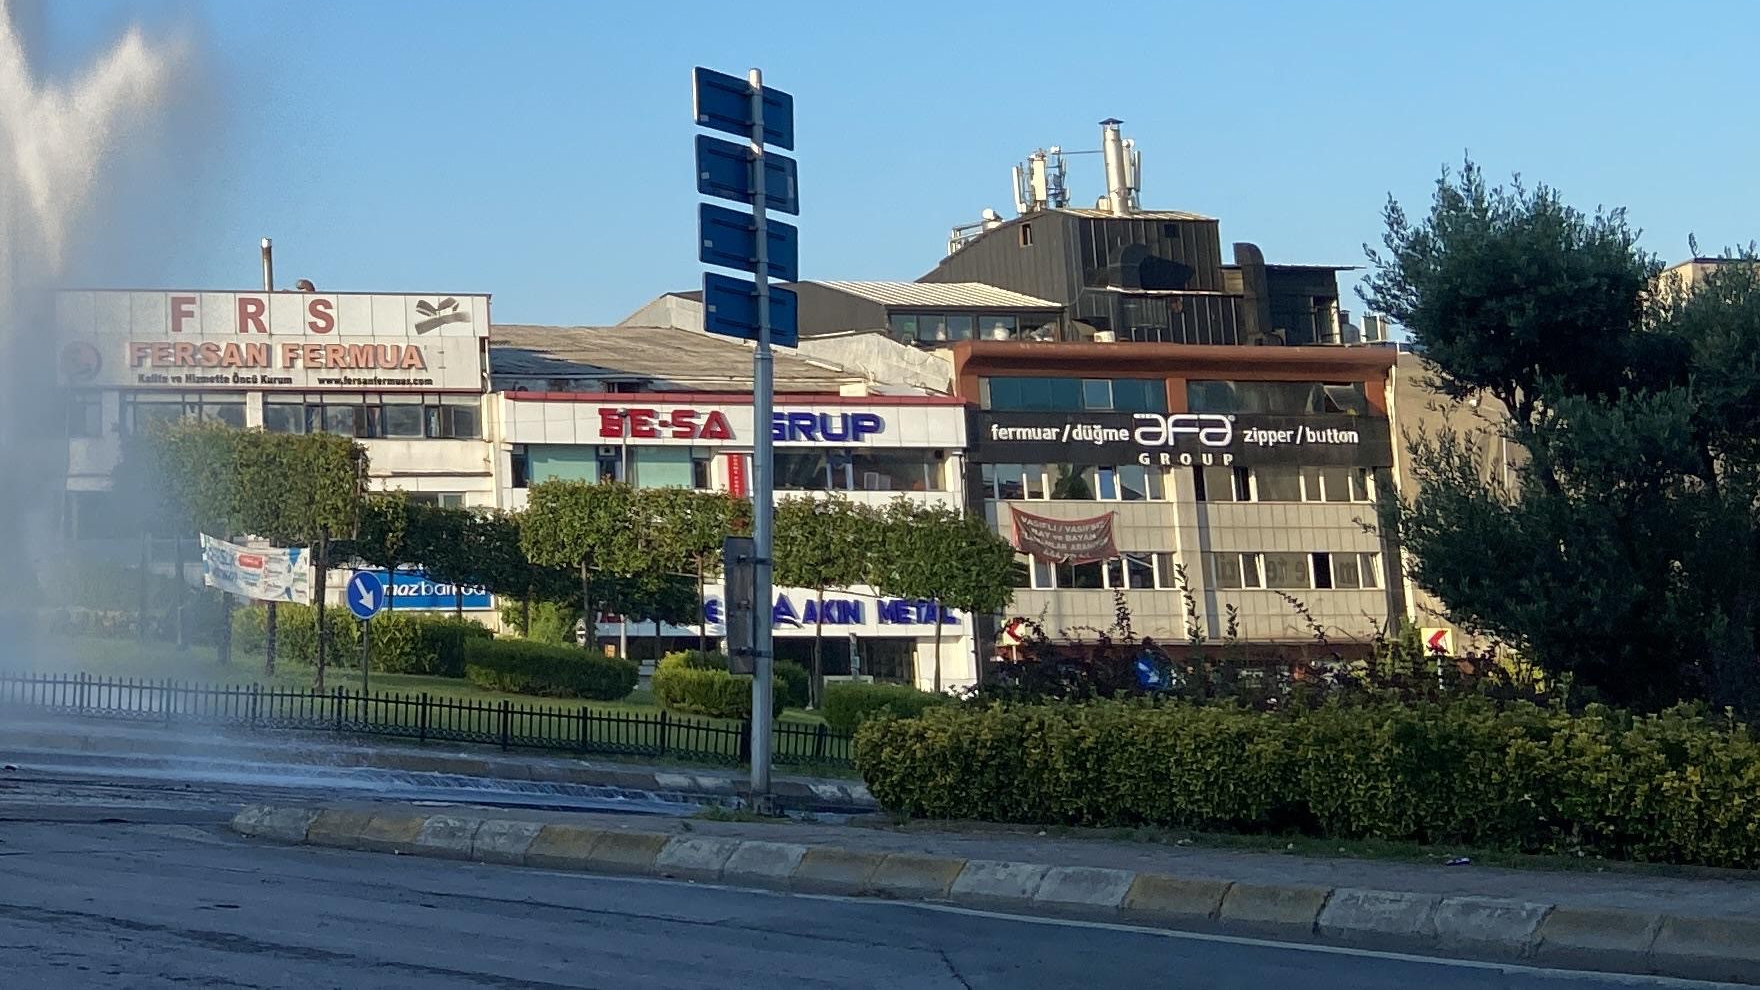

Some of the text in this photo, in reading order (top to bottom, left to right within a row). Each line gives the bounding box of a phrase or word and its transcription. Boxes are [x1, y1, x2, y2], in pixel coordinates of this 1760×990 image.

[130, 342, 426, 370] FERSAN FERMUA
[261, 375, 293, 384] Kurum
[1138, 452, 1232, 466] GROUP
[802, 599, 862, 624] AKIN
[877, 599, 958, 624] METAL
